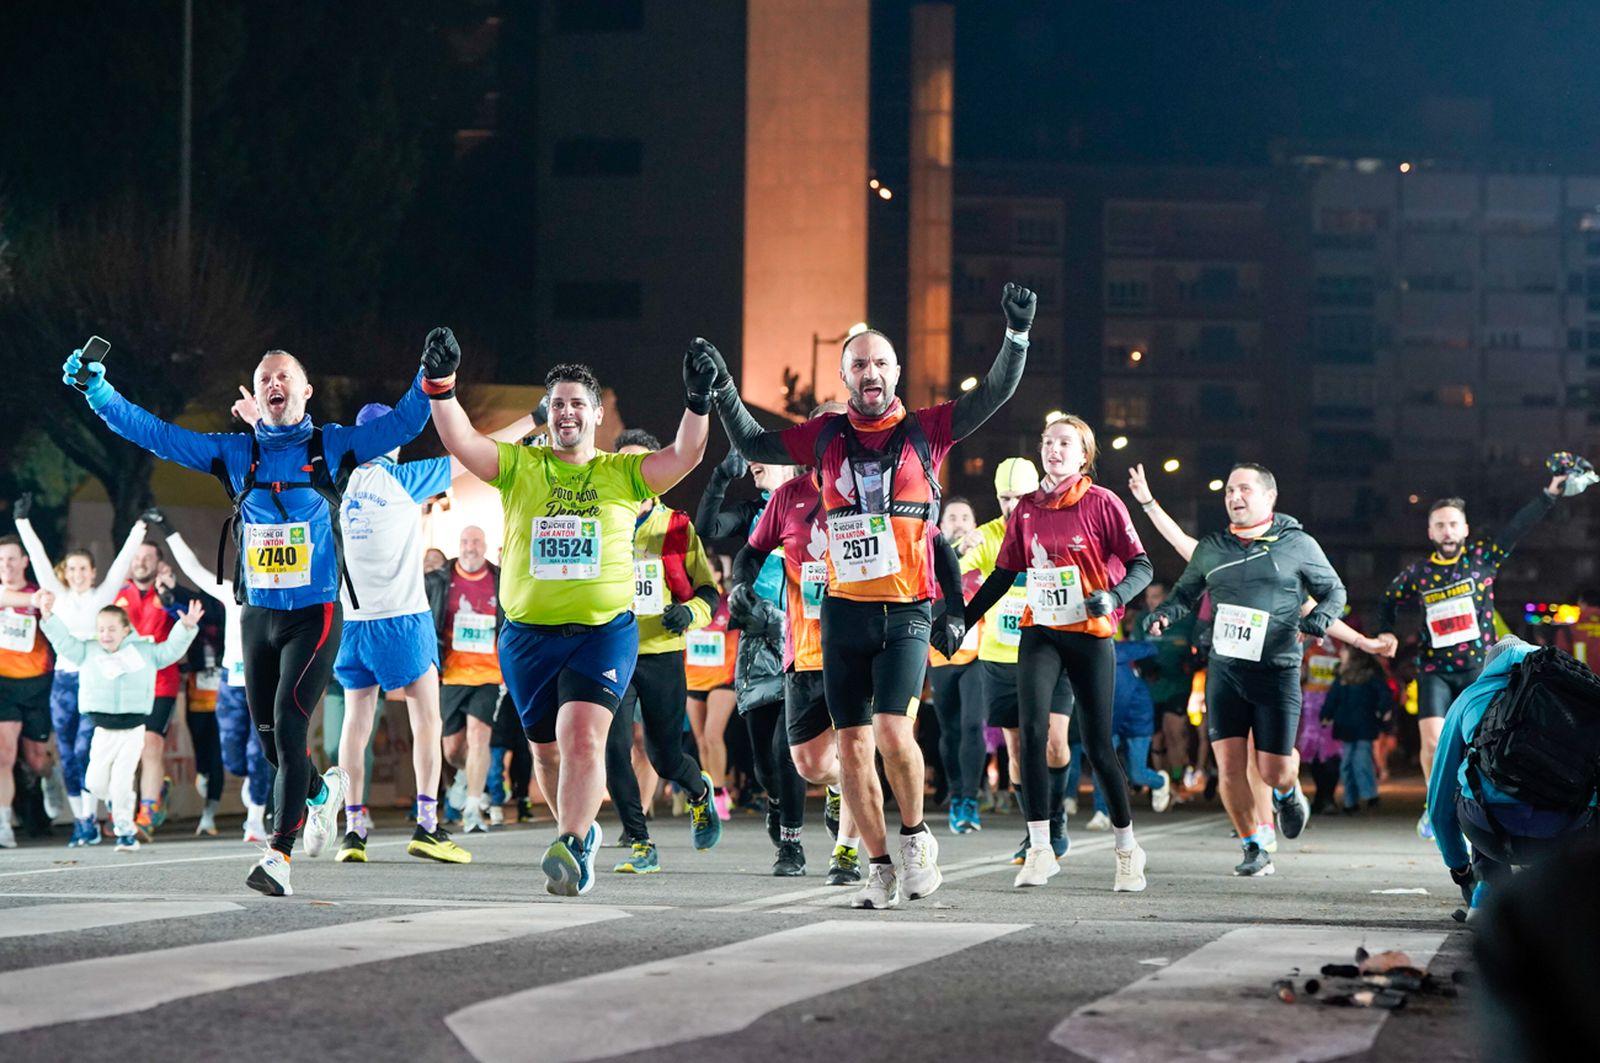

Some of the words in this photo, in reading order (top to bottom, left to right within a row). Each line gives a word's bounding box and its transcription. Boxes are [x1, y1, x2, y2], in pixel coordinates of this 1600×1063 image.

[257, 547, 297, 566] 2740
[538, 538, 593, 557] 13524
[843, 536, 879, 560] 2677
[1038, 588, 1067, 606] 4617
[1224, 623, 1251, 641] 7314
